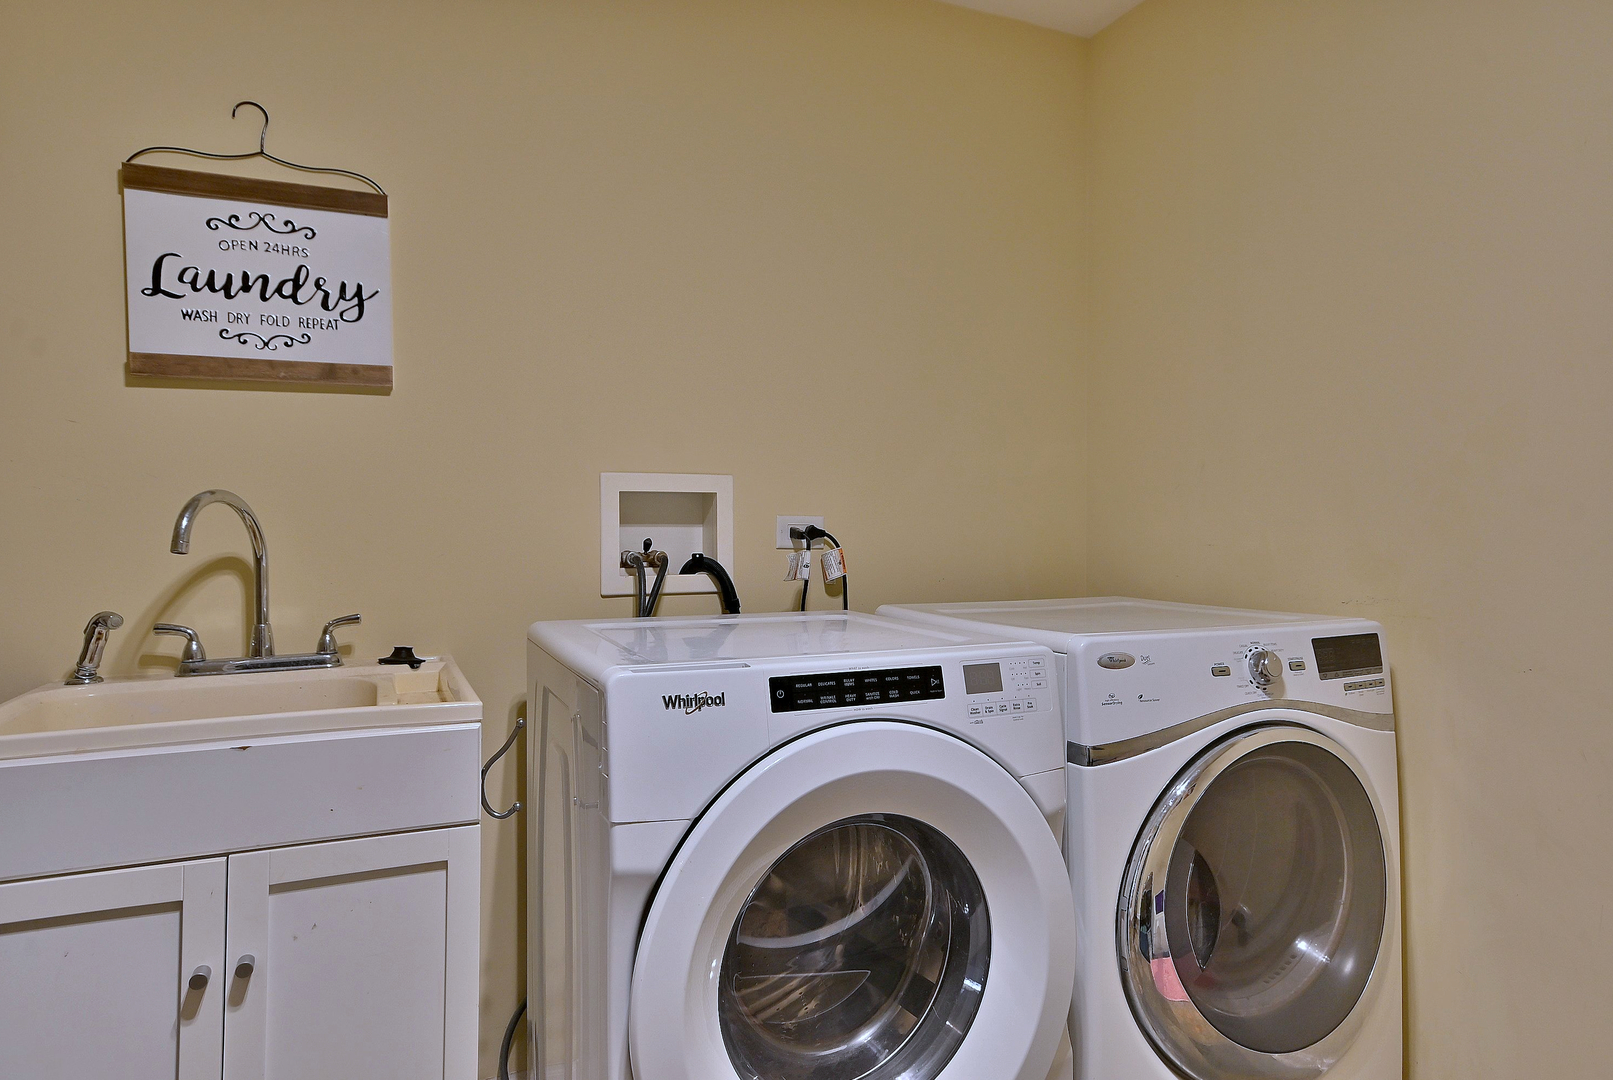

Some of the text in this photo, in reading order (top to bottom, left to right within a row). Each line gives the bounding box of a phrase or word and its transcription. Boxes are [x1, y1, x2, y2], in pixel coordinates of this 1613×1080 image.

[218, 239, 310, 258] OPEN 24HRS
[140, 252, 380, 323] Laundry
[181, 308, 341, 331] WASH DRY FOLD REPEAT
[662, 691, 725, 714] Whirlpool
